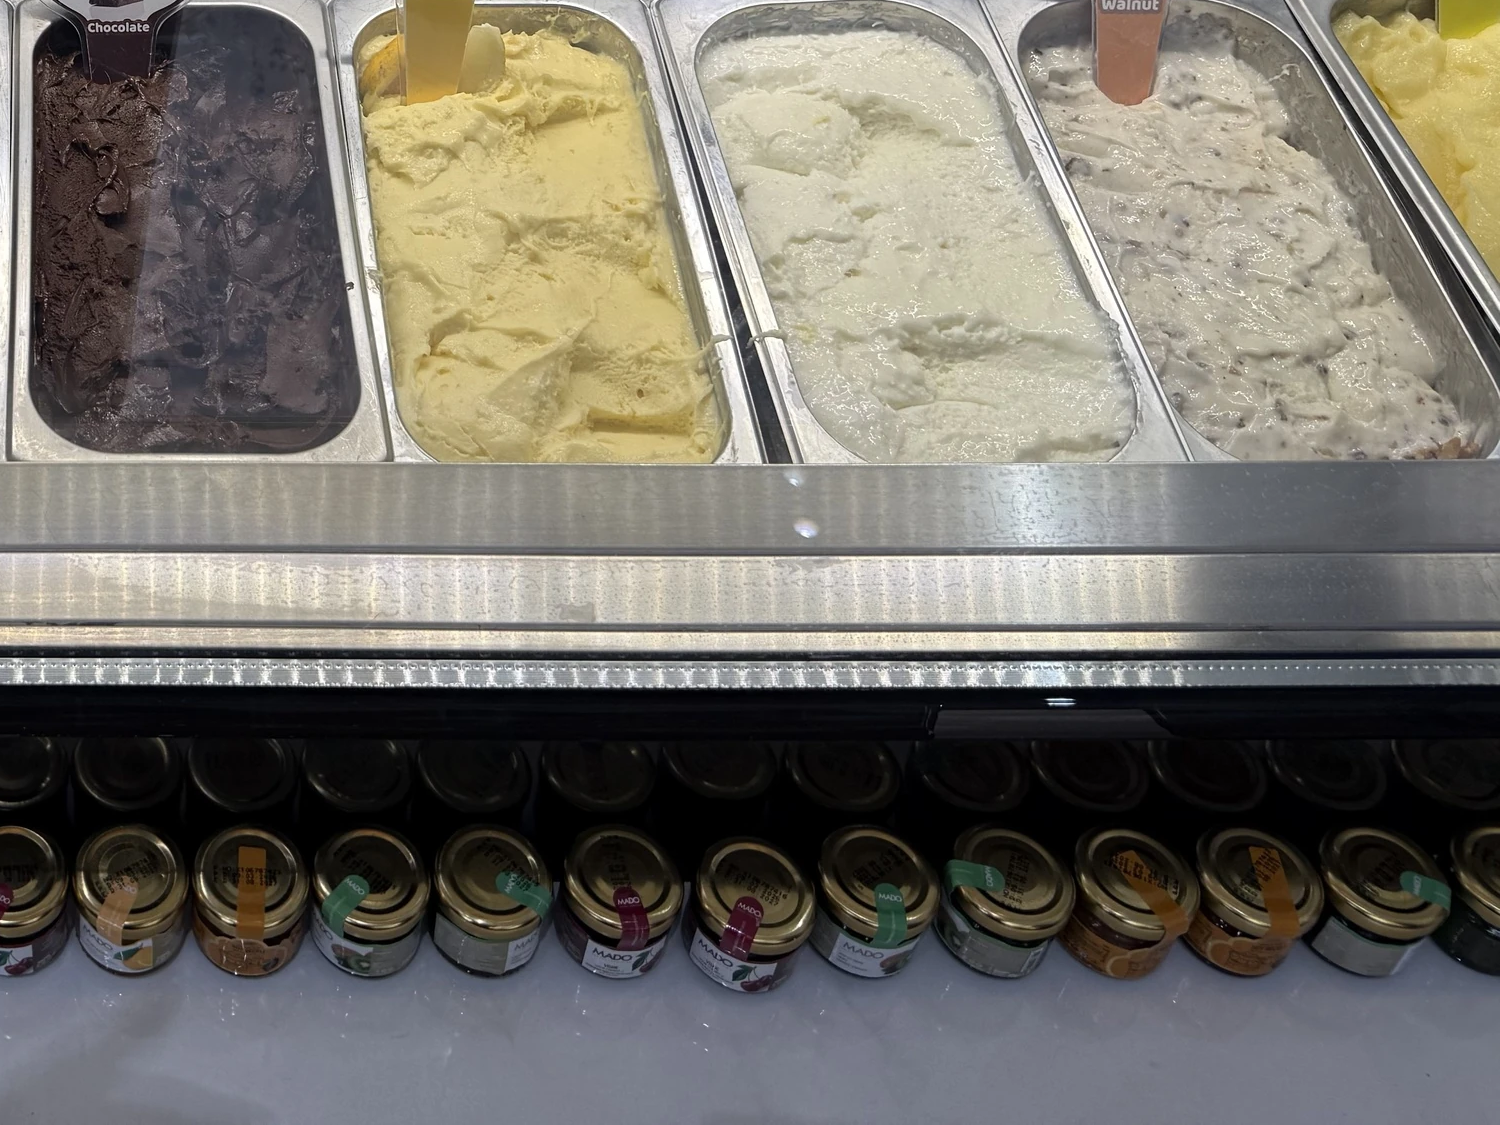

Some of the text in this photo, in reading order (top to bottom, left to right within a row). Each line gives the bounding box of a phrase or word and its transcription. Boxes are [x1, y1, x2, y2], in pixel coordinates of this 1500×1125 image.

[1101, 0, 1160, 12] Walnut
[88, 22, 152, 34] Chocolate
[346, 879, 365, 895] MADO
[618, 896, 640, 905] MADO
[879, 892, 902, 903] MADO
[738, 902, 761, 917] MADO
[83, 925, 112, 951] MADO
[592, 947, 632, 961] MADO
[698, 939, 733, 967] MADO
[843, 942, 884, 959] MADO
